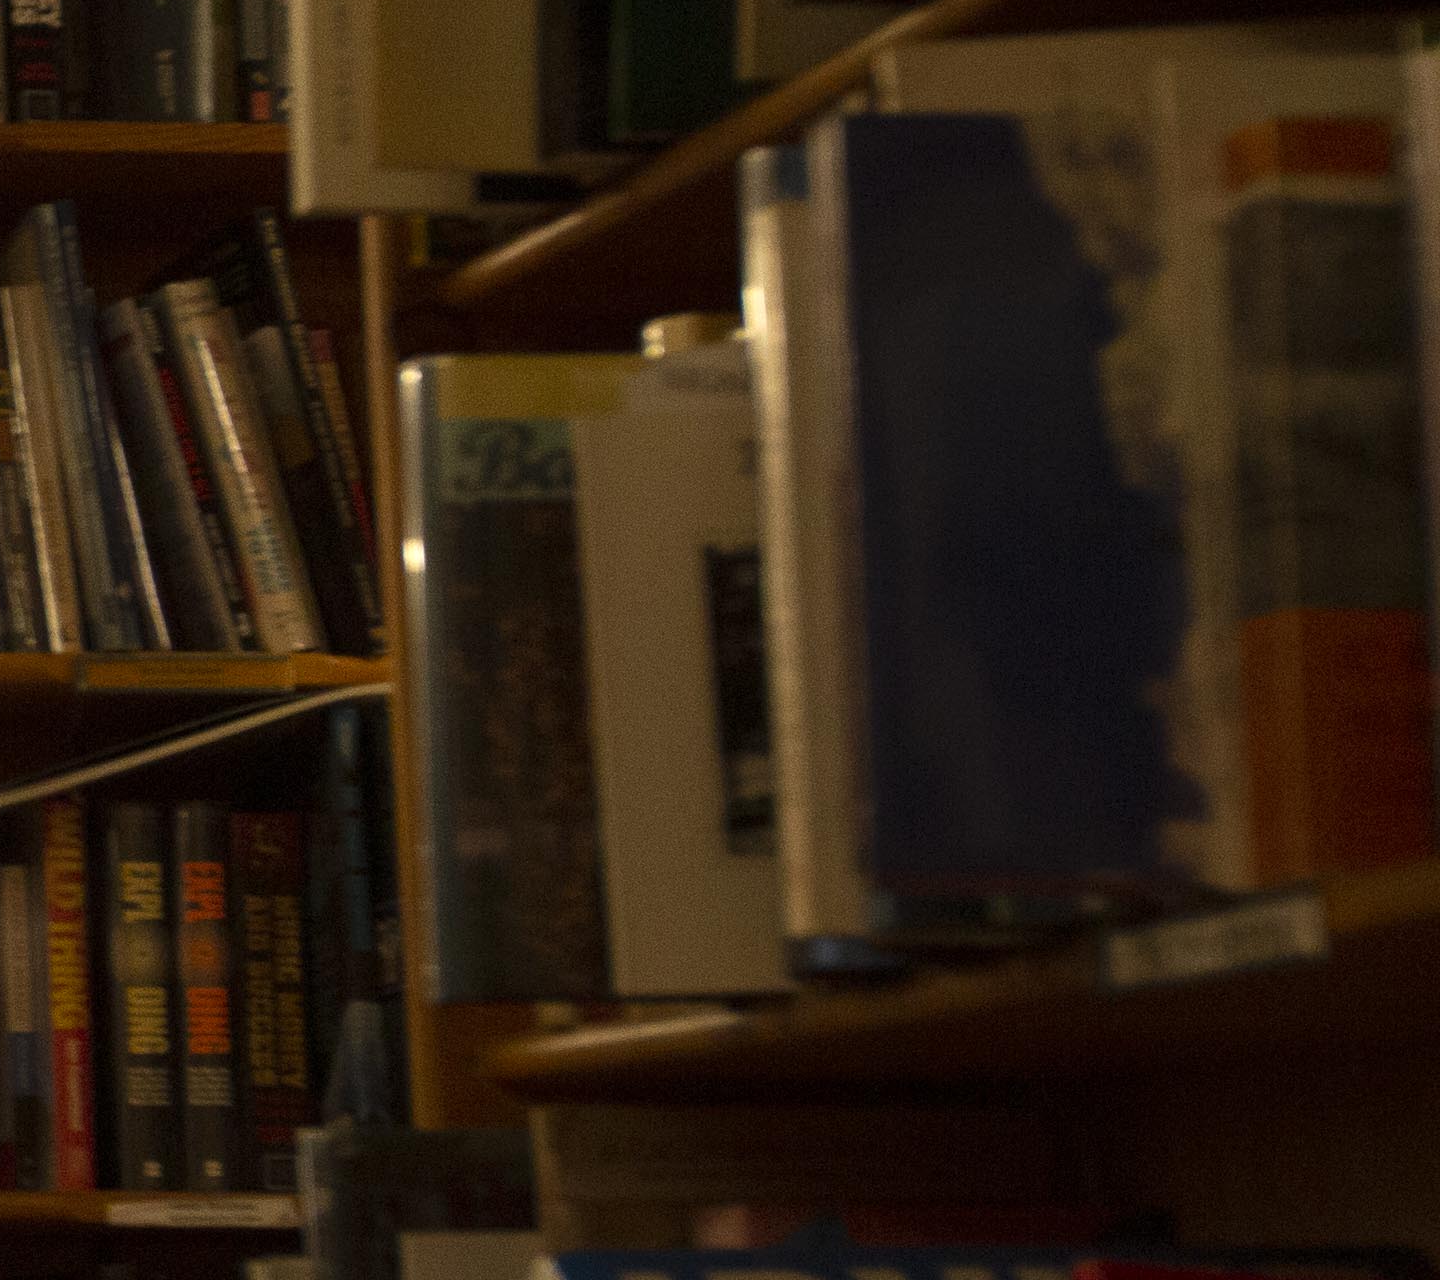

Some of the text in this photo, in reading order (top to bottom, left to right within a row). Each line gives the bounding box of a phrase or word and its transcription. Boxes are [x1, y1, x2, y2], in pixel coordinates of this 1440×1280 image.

[46, 807, 88, 1030] WILD THING
[279, 992, 307, 1088] MONEY
